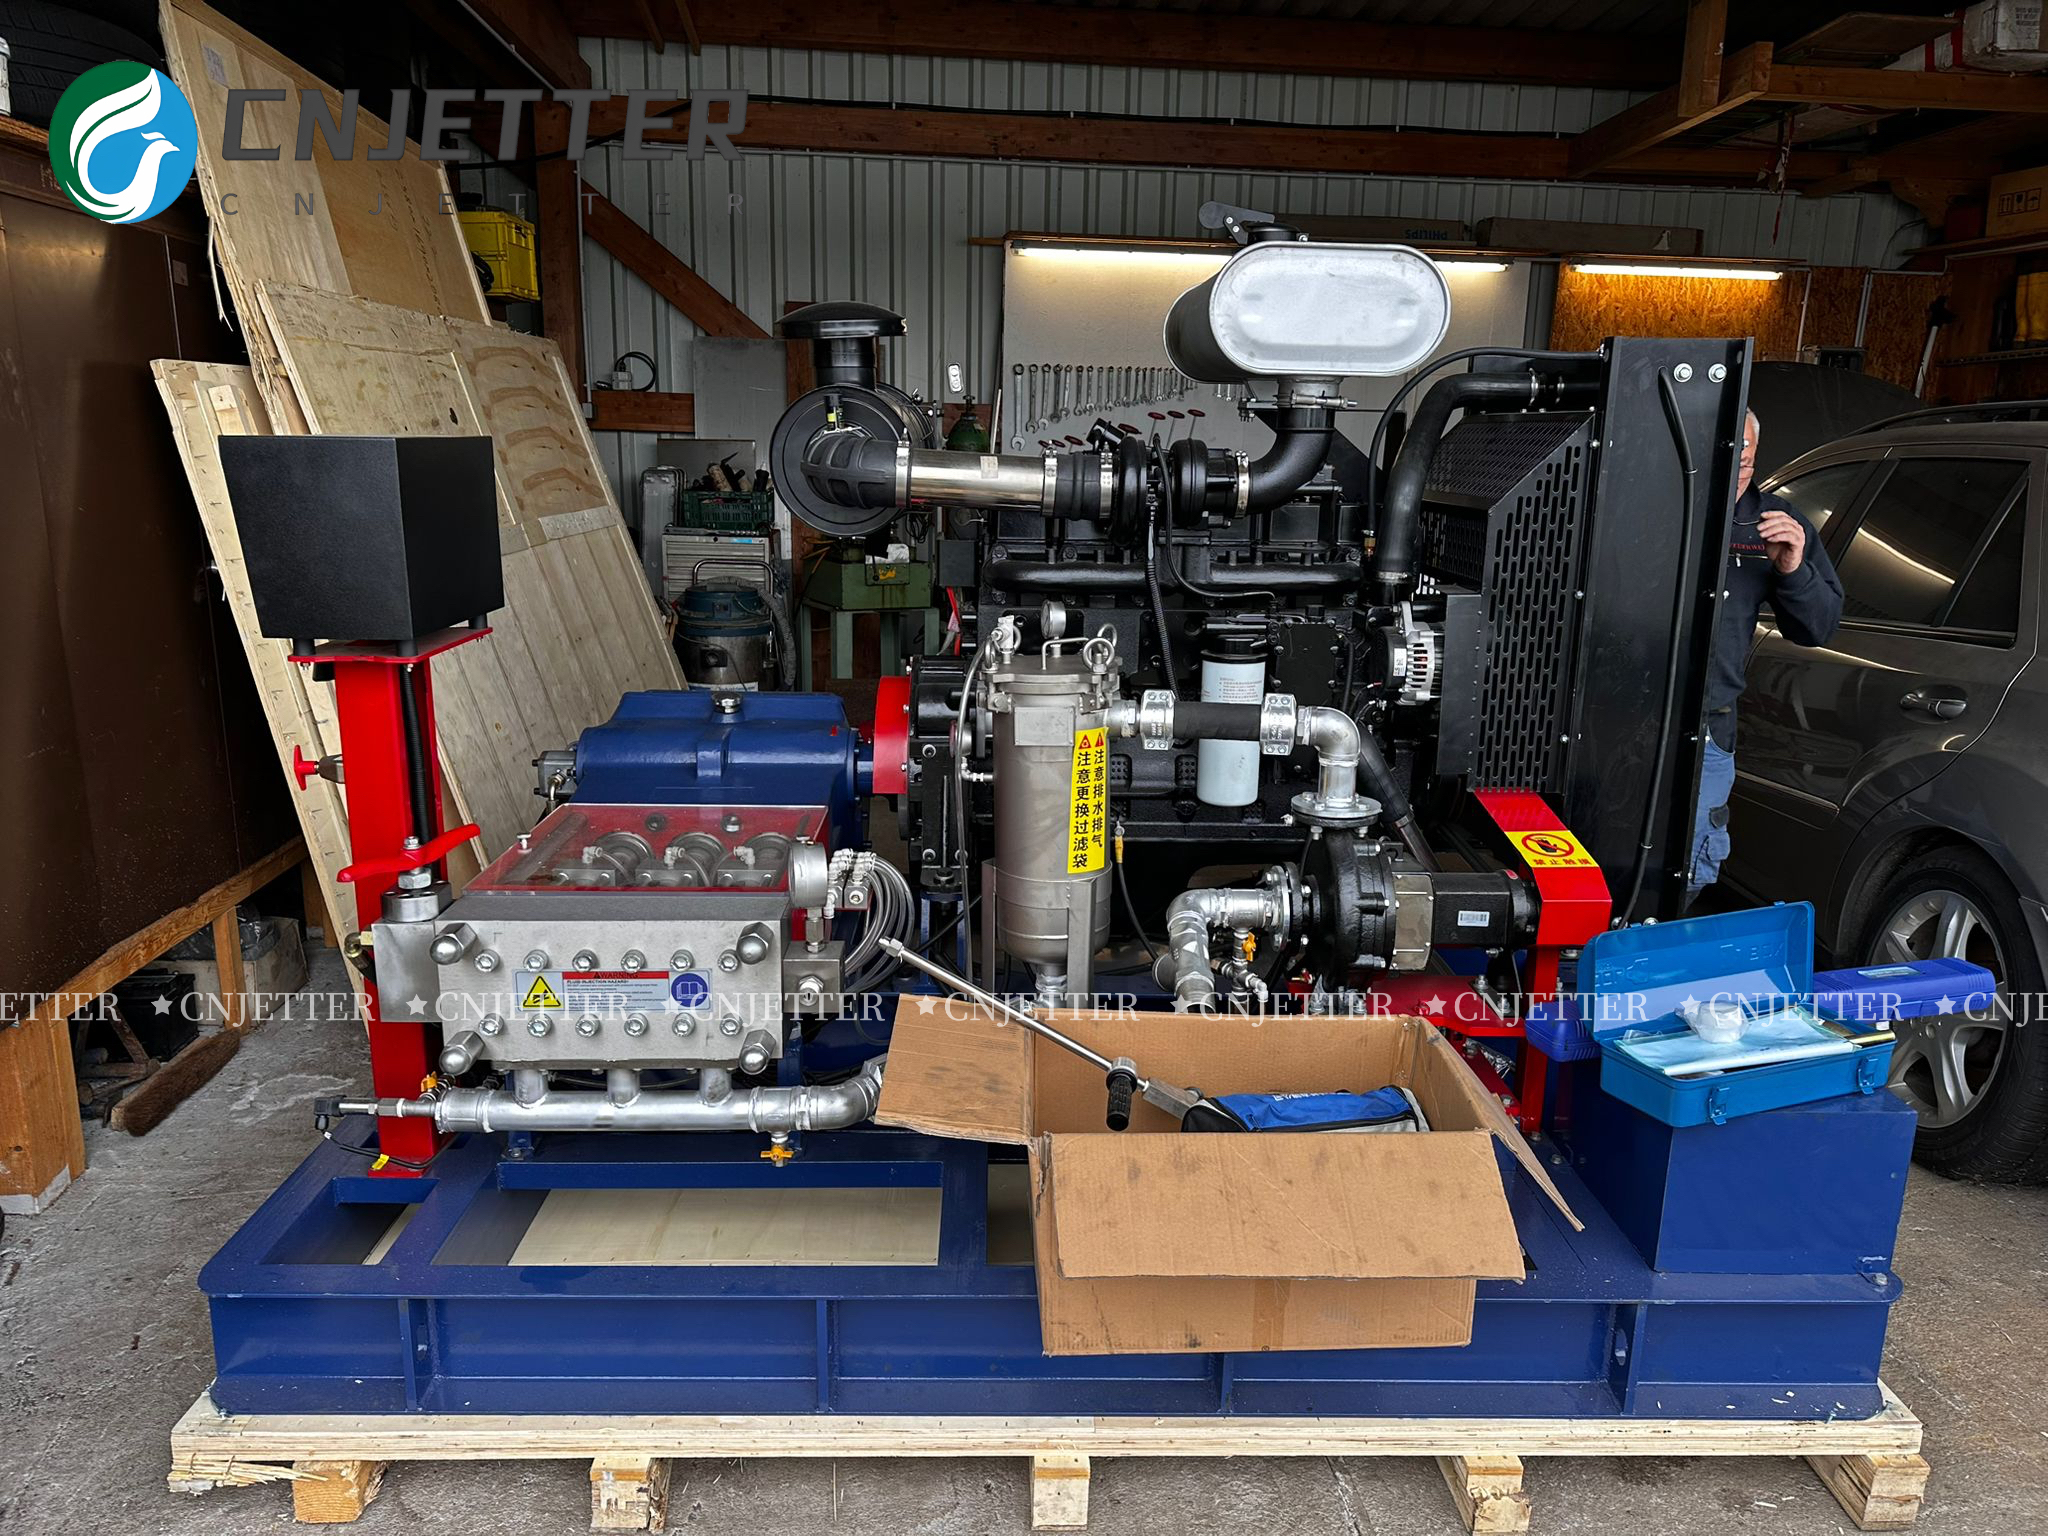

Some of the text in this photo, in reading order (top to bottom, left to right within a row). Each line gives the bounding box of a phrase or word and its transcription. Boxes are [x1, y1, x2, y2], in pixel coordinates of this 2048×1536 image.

[1072, 752, 1092, 868] 注意更换过滤袋
[1092, 749, 1105, 848] 注意排水排气
